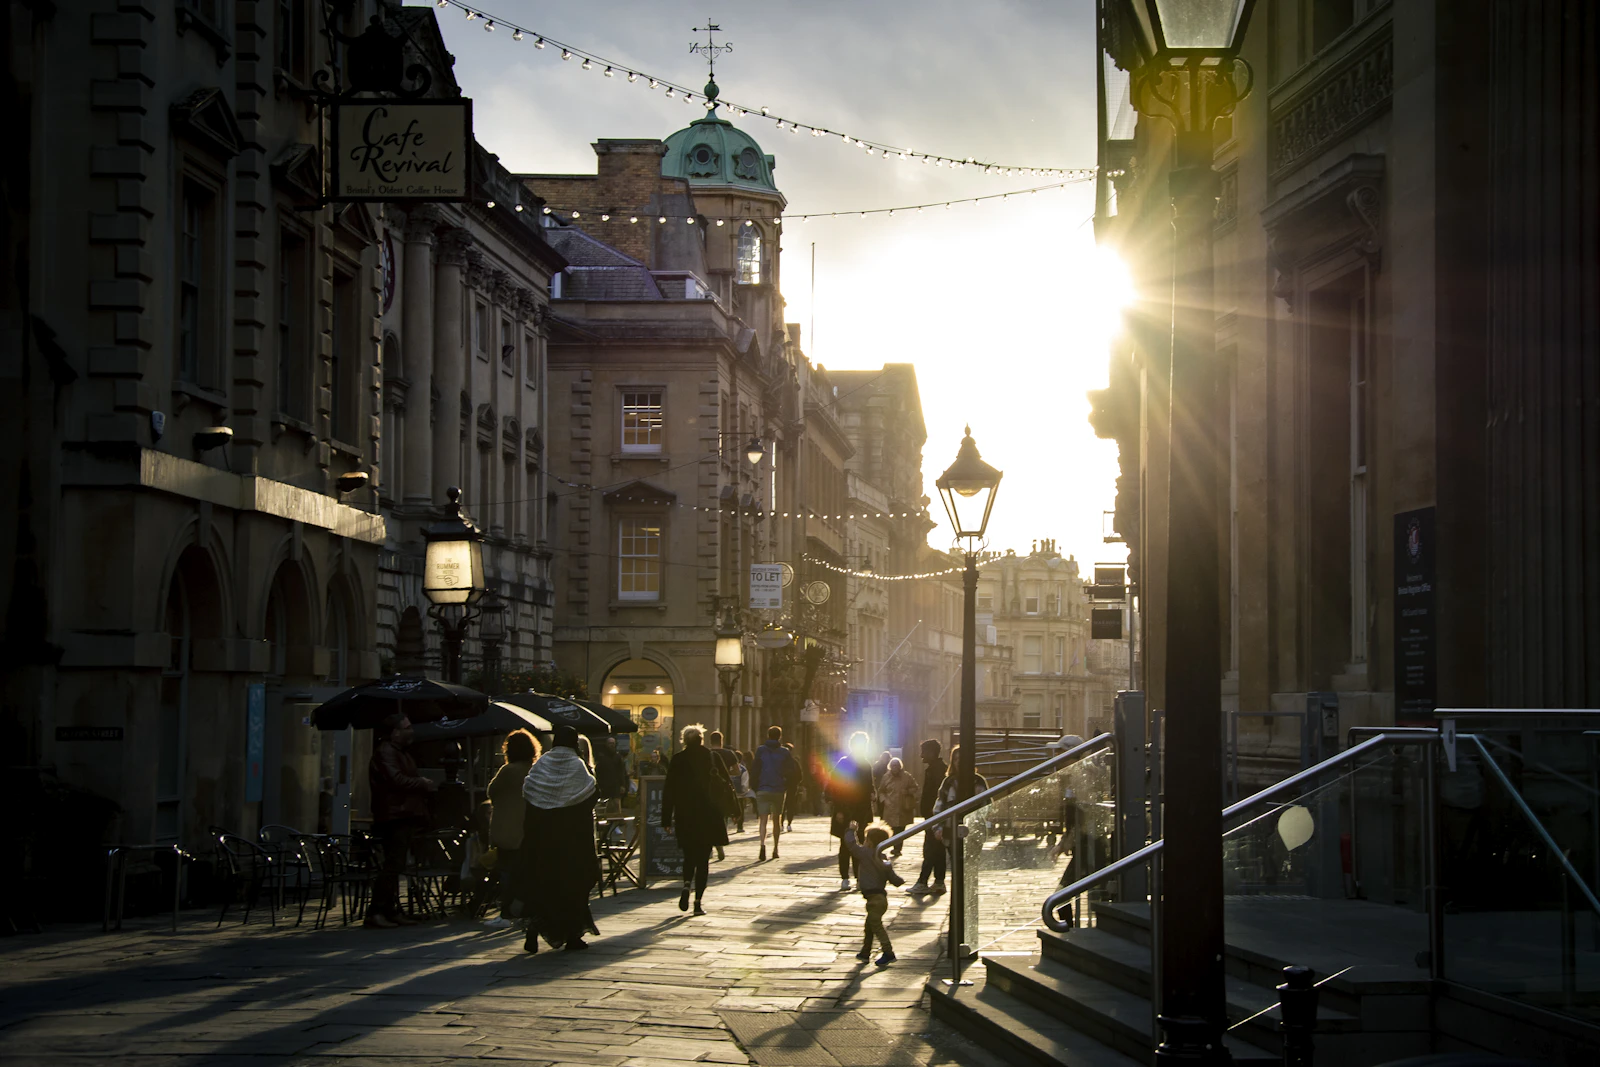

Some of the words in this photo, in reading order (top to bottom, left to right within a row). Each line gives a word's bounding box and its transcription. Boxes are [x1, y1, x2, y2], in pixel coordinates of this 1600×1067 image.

[363, 107, 424, 155] Cafe
[350, 146, 453, 183] Revival
[346, 185, 375, 194] Bristol's
[379, 185, 403, 194] Oldest
[406, 185, 430, 194] Coffee
[434, 185, 458, 194] House
[751, 572, 763, 581] TO
[765, 572, 780, 581] LET
